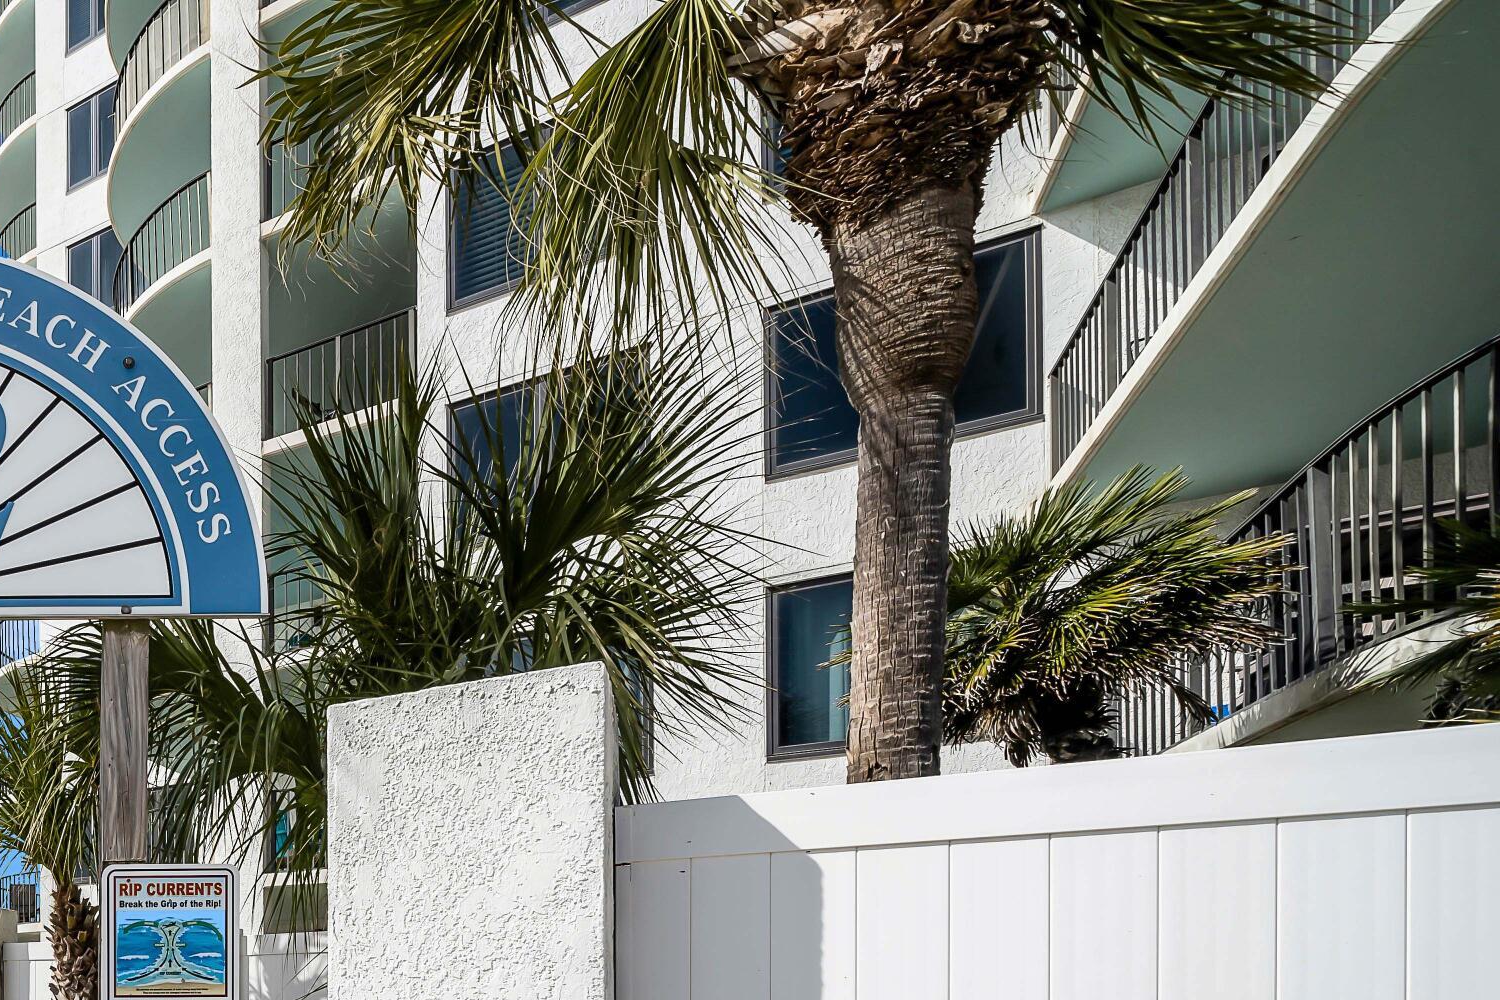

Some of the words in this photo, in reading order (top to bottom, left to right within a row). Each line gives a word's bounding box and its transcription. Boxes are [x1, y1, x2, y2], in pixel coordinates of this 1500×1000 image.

[111, 375, 231, 545] ACCESS
[119, 883, 142, 896] RIP
[146, 882, 223, 896] CURRENTS
[119, 900, 143, 909] Break
[145, 900, 158, 909] the
[160, 900, 178, 909] Grip
[179, 900, 188, 909] of
[190, 900, 203, 909] the
[205, 900, 221, 909] Rip!
